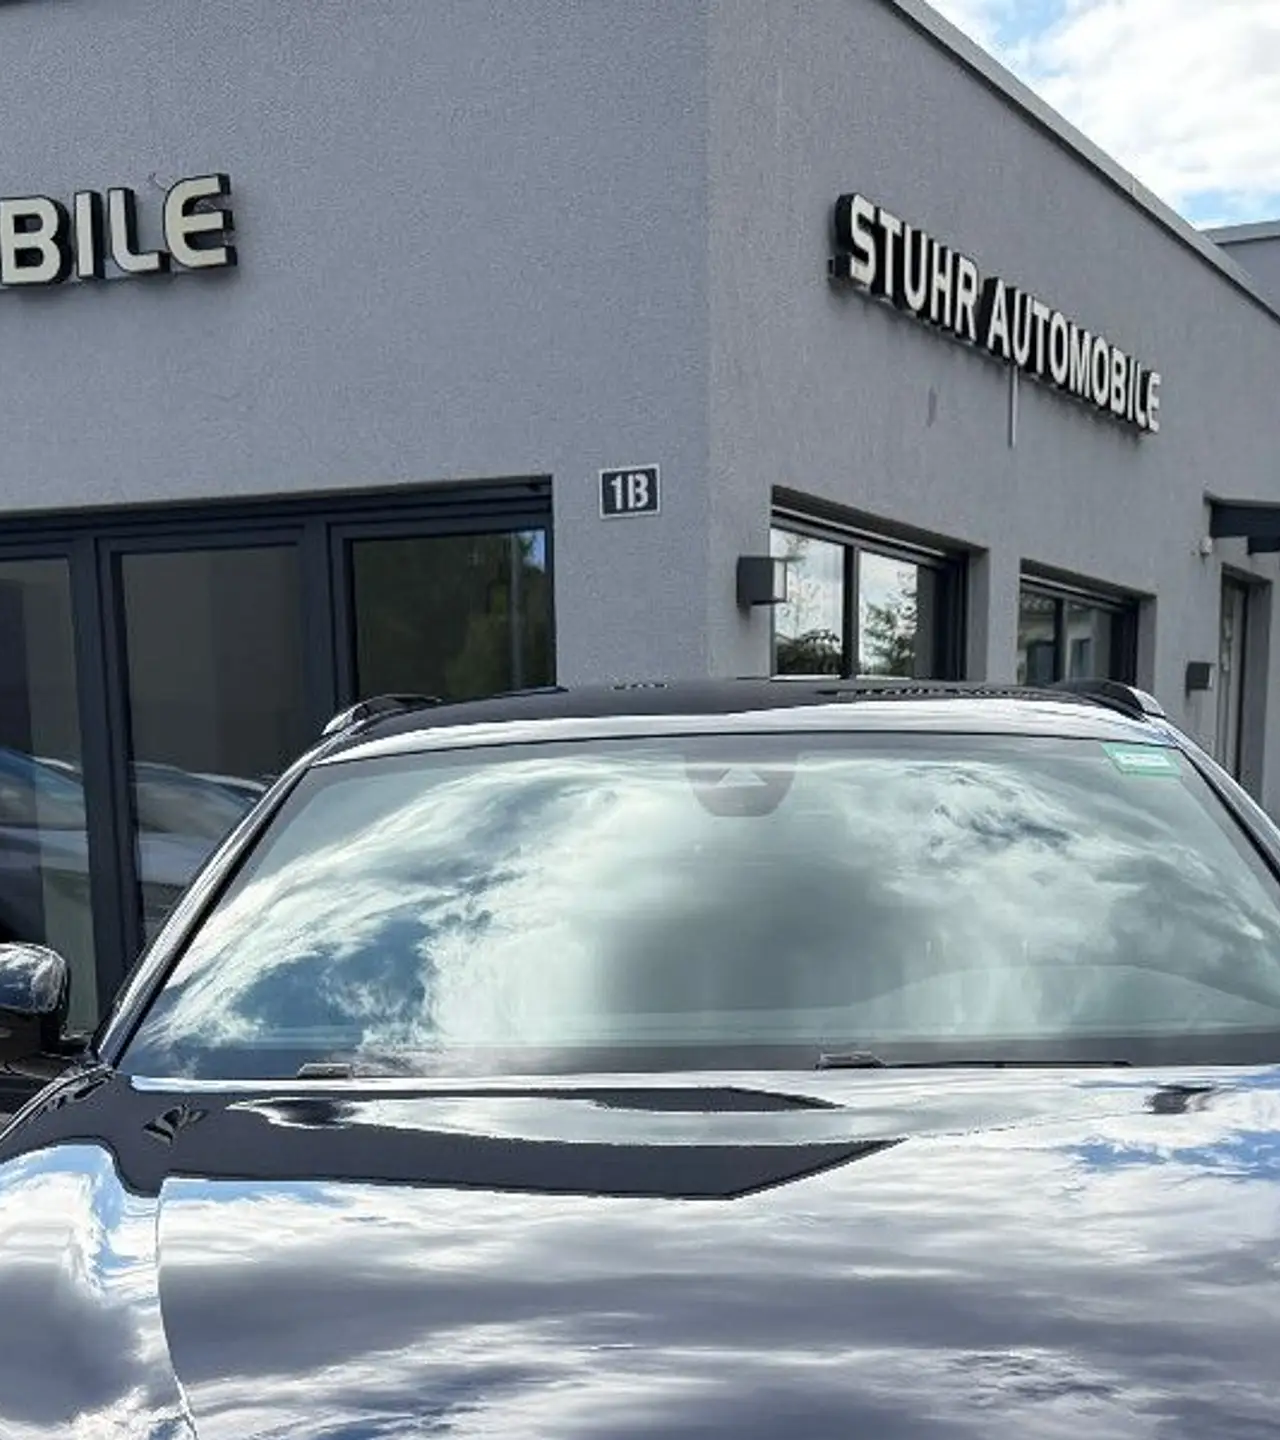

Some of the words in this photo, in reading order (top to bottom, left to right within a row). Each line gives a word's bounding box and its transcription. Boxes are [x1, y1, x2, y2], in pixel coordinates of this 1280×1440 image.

[836, 193, 978, 342] STUHR
[984, 276, 1162, 433] AUTOMOBILE
[611, 472, 649, 510] 1B
